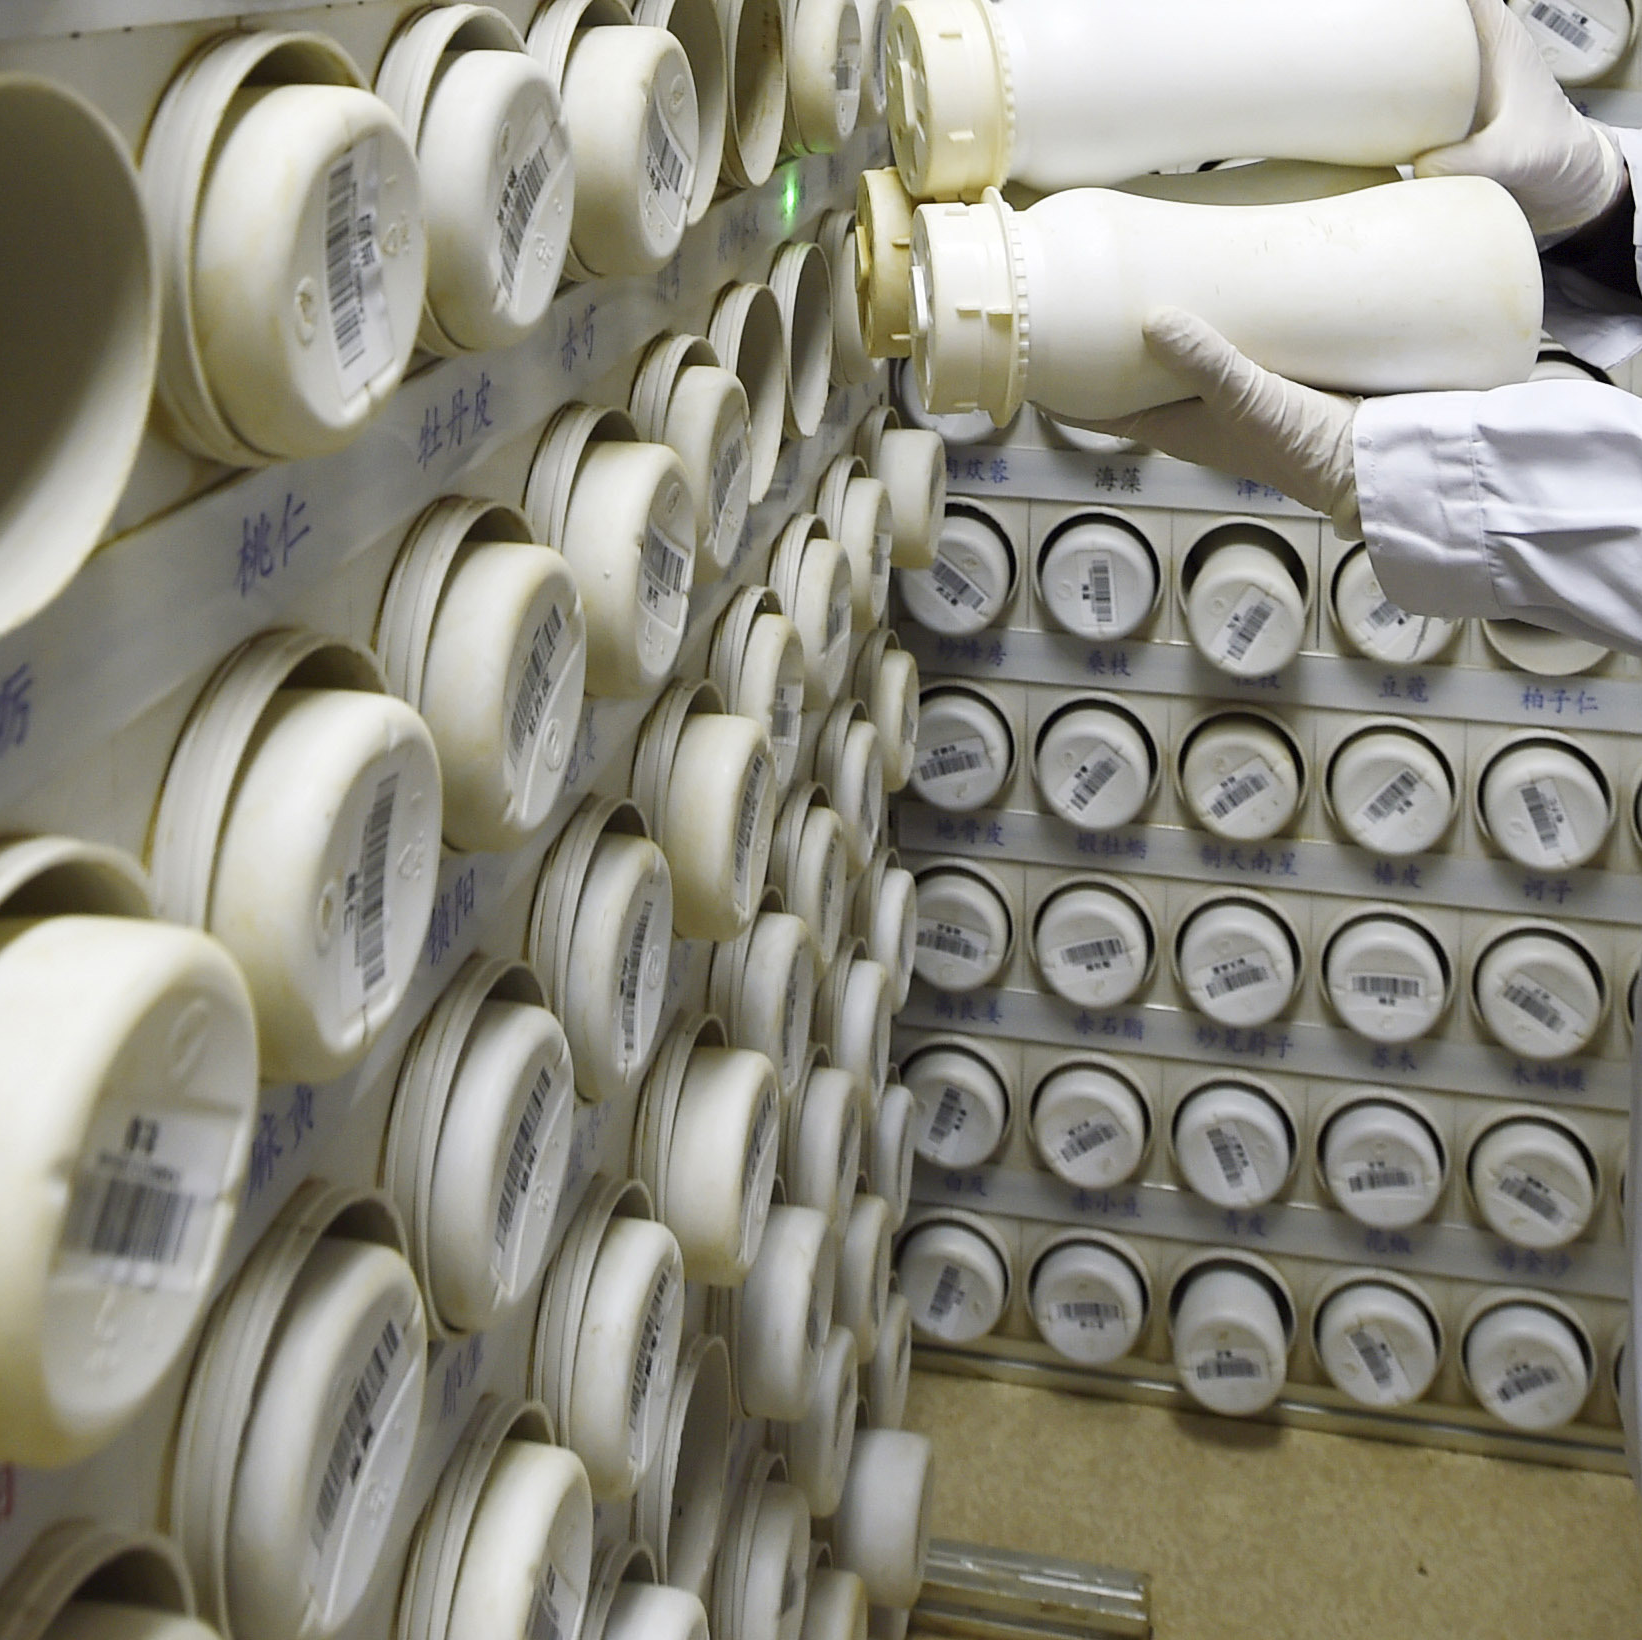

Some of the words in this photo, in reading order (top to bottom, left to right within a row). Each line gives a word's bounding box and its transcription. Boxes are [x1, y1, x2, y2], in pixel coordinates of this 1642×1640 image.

[417, 371, 493, 464] 牡丹皮
[234, 491, 311, 597] 桃仁
[1522, 688, 1599, 715] 柏子仁
